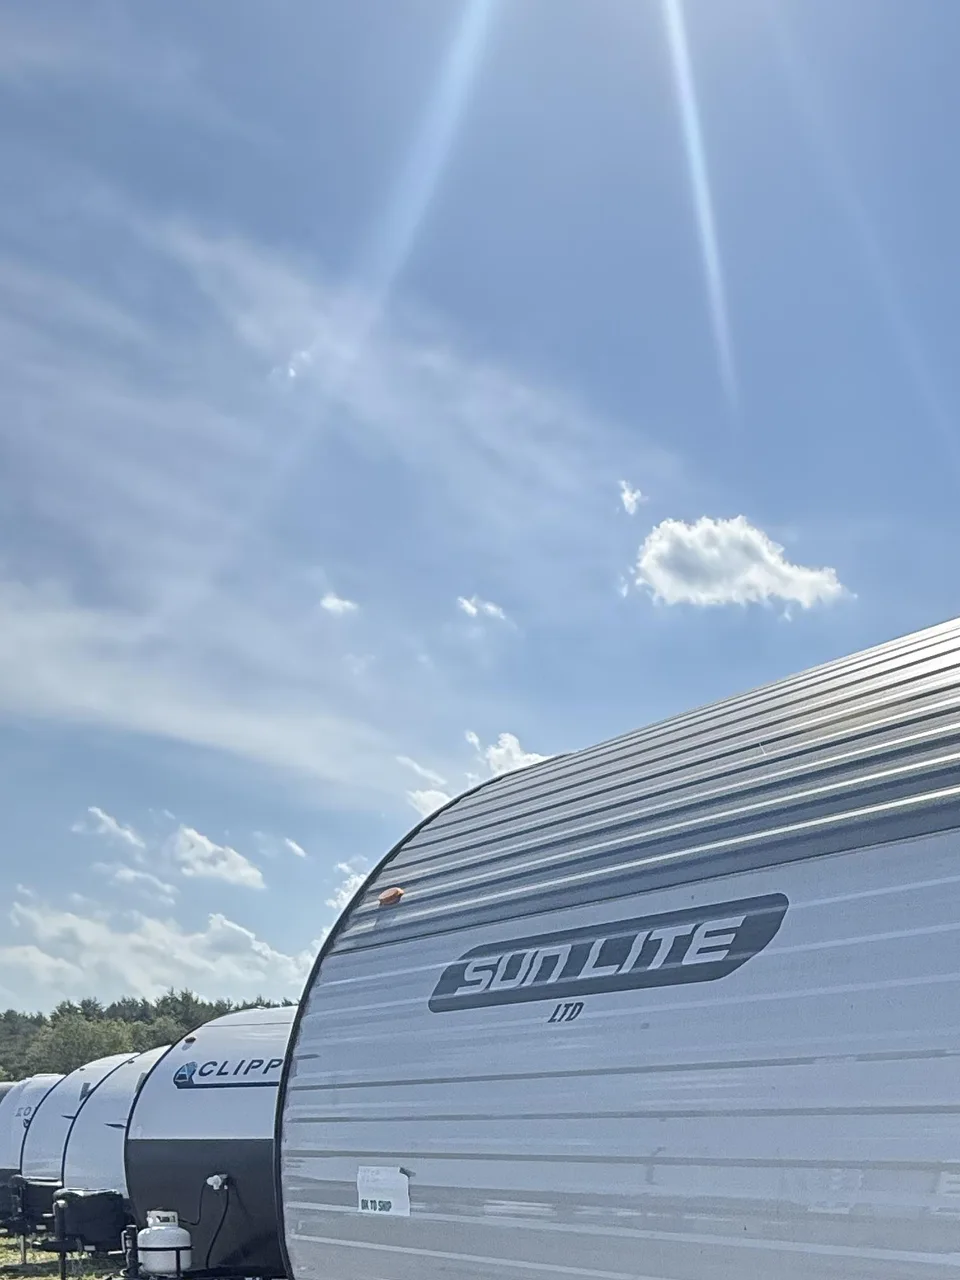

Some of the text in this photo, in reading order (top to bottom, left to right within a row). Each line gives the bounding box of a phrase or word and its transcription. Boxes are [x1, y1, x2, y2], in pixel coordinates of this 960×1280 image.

[453, 915, 748, 996] SUN LITE
[547, 1002, 585, 1023] LTD
[198, 1058, 284, 1077] CLIPP
